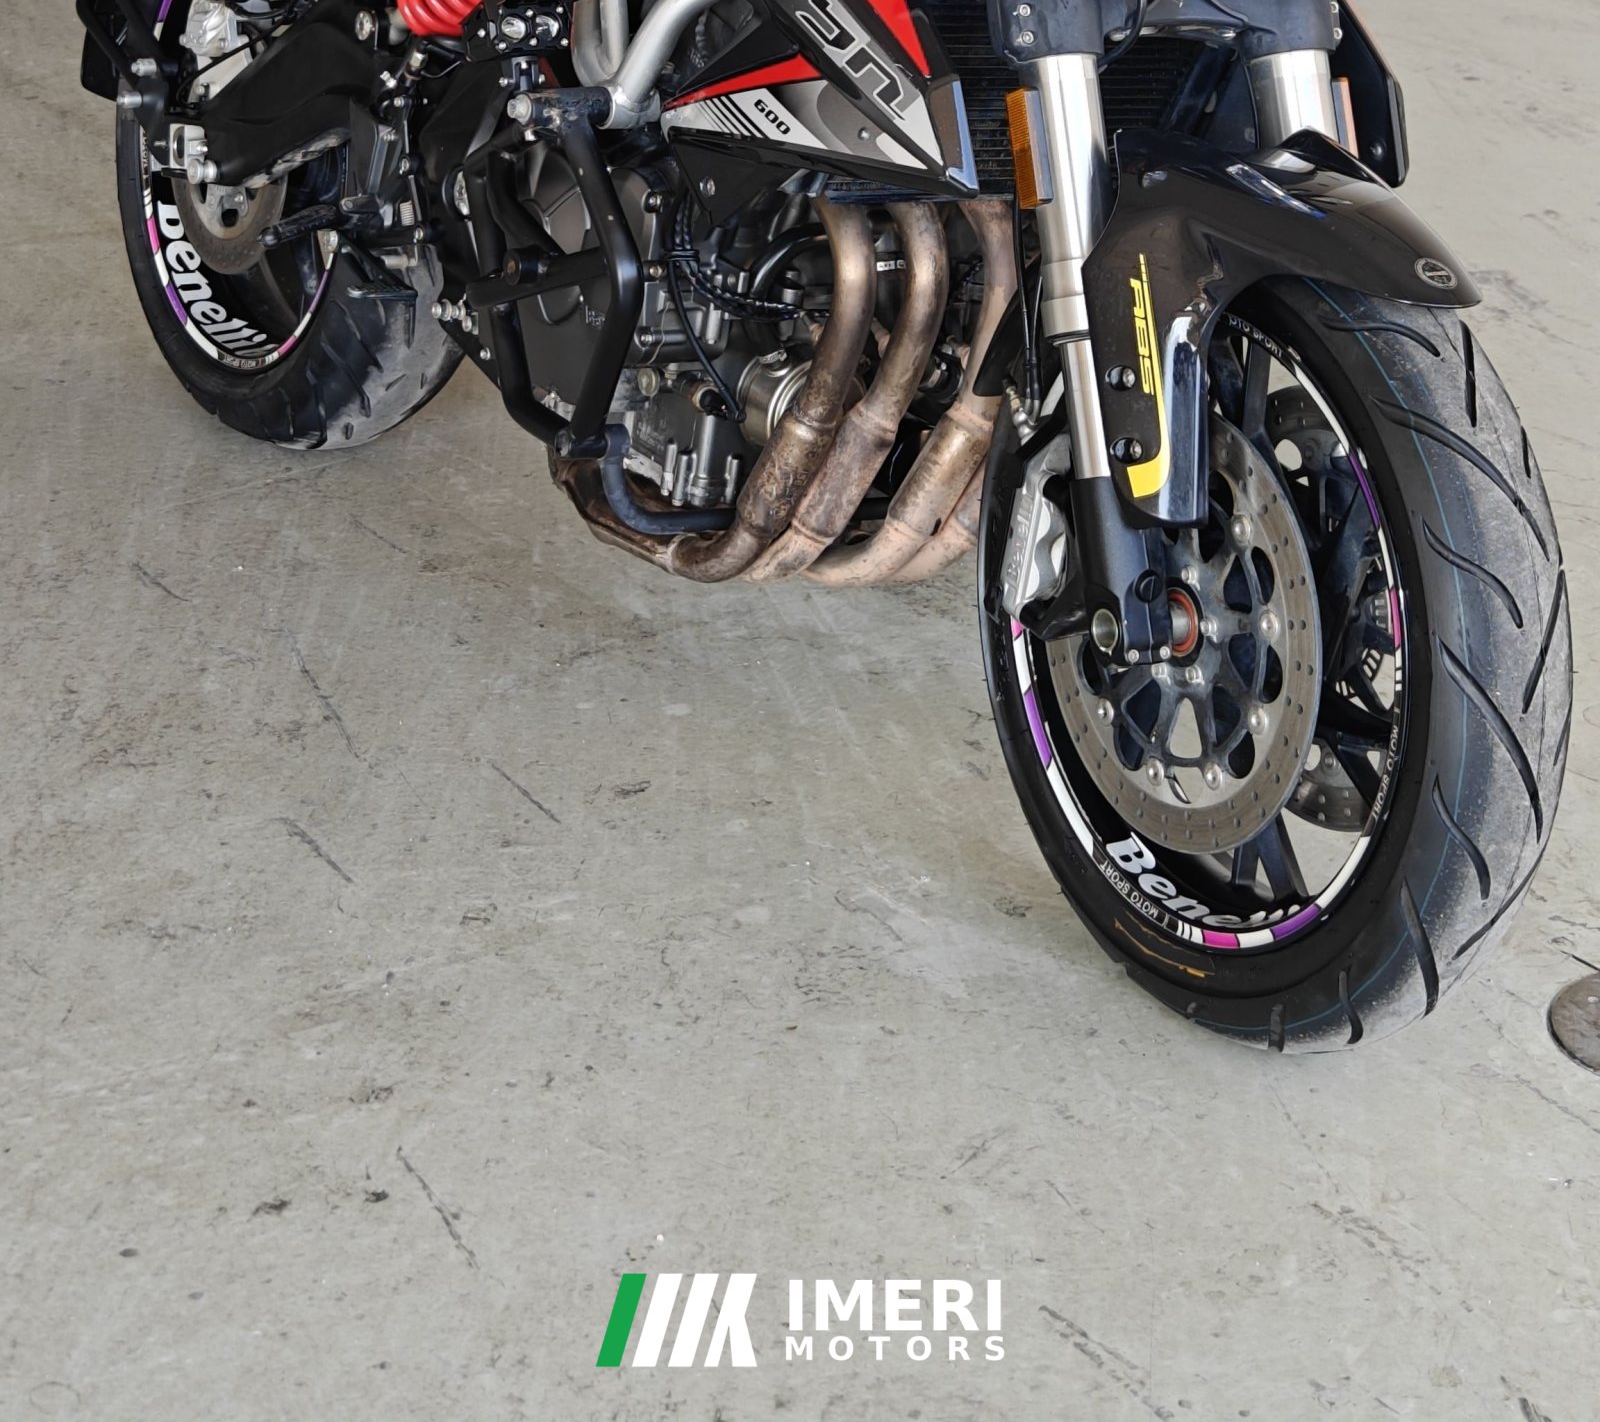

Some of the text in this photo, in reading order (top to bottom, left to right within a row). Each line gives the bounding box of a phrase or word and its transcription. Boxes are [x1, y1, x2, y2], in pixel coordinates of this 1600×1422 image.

[754, 99, 791, 135] 600
[1130, 278, 1154, 395] ABS
[1100, 859, 1159, 920] MOTO SPORT
